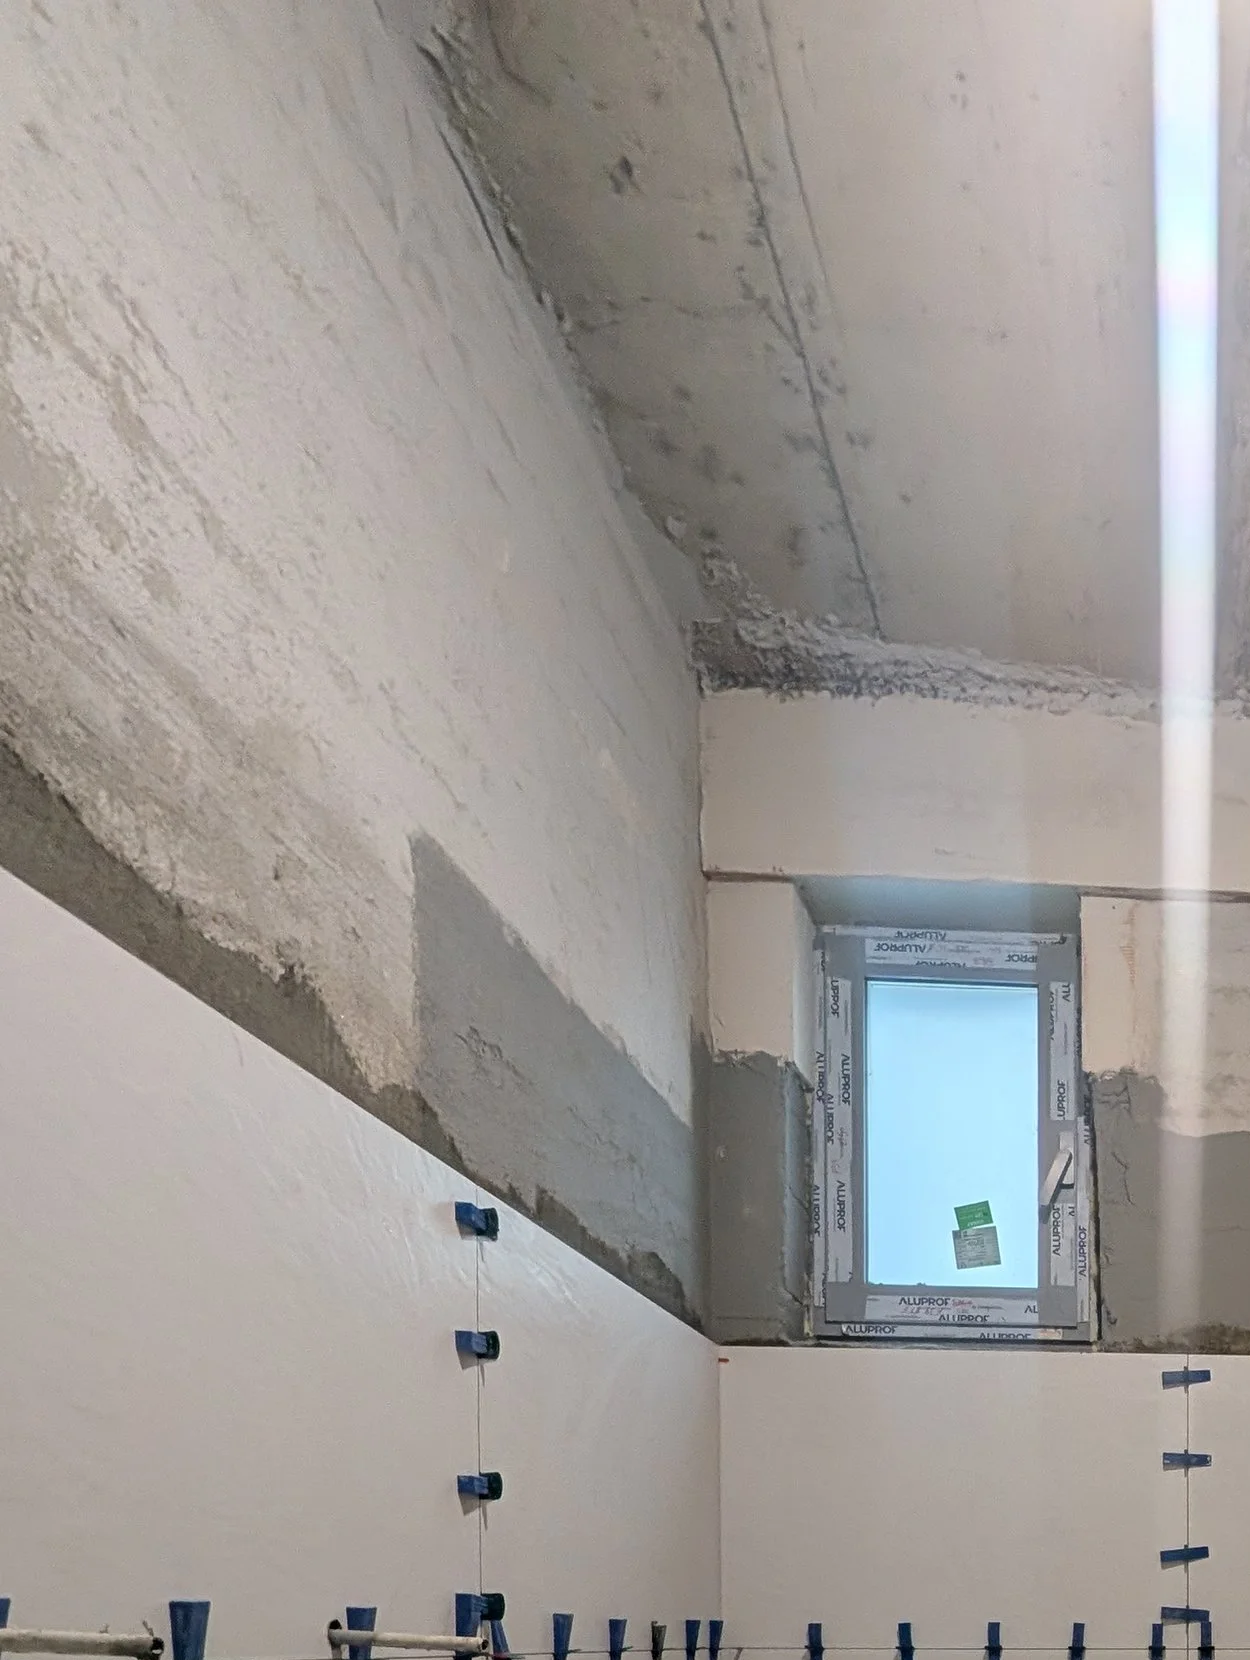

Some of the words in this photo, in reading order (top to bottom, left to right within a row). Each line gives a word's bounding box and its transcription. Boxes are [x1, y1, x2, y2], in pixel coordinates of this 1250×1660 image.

[874, 942, 926, 953] ALUPROF
[841, 1053, 850, 1105] ALUPROF
[836, 1180, 846, 1233] ALUPROF
[1052, 1205, 1061, 1256] ALUPROF
[1078, 1226, 1087, 1277] ALUPROF
[899, 1296, 951, 1307] ALUPROF
[846, 1325, 897, 1334] ALUPROF
